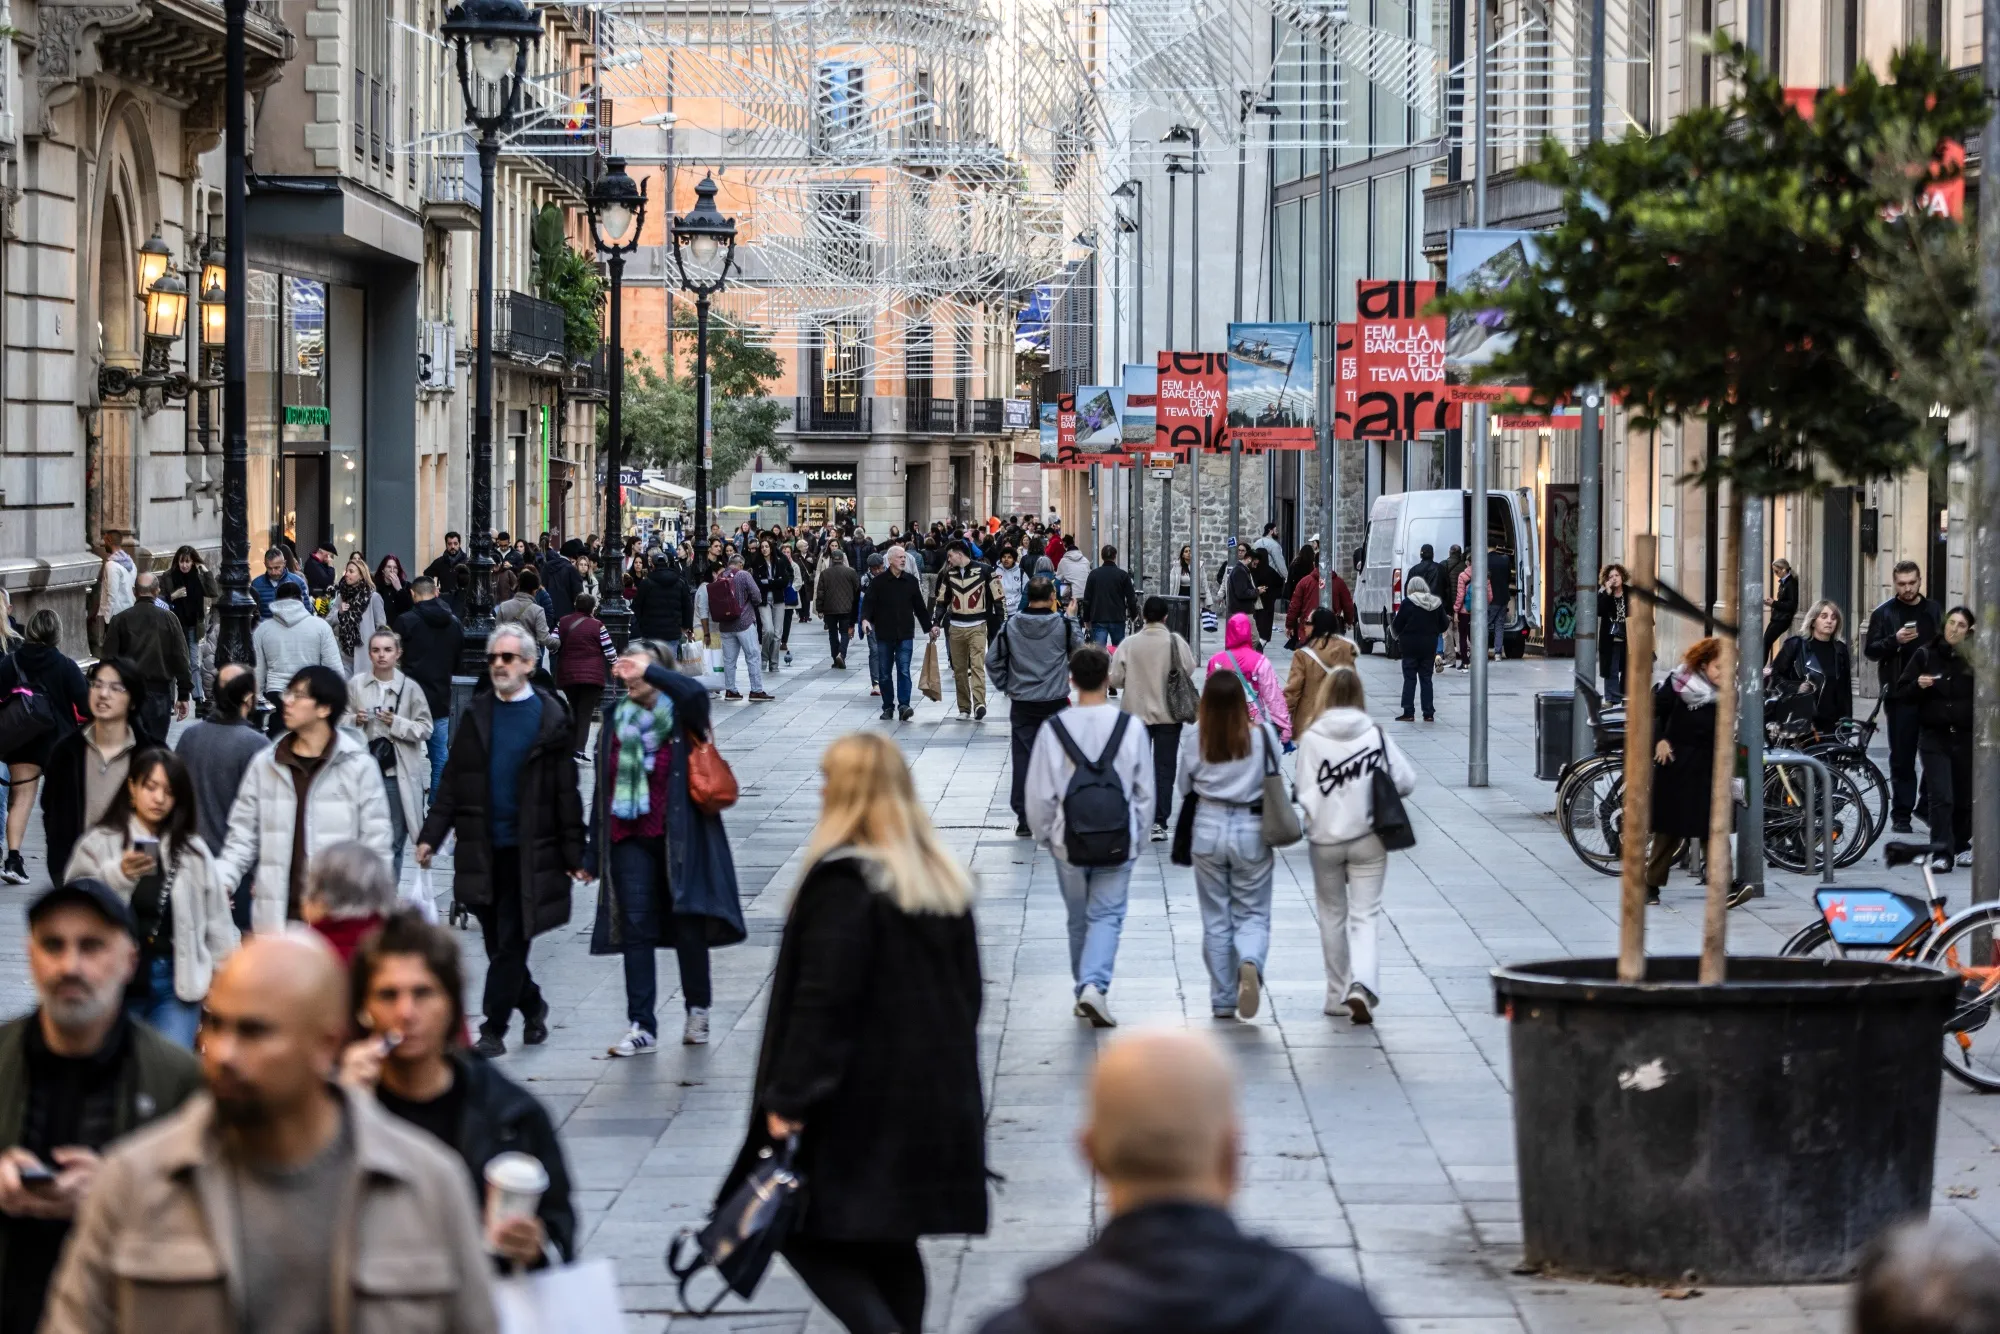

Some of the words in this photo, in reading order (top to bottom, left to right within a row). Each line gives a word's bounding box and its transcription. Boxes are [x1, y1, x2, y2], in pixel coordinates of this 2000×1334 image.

[1364, 325, 1396, 340] FEM
[1408, 325, 1429, 340] LA
[1407, 354, 1429, 368] DE
[1368, 367, 1408, 382] TEVA
[1410, 368, 1446, 382] VIDA
[1161, 380, 1183, 390] FEM
[1190, 380, 1204, 390] LA
[1161, 389, 1222, 400] BARCELONA
[1451, 389, 1501, 400] Barcelona
[1189, 399, 1203, 409] DE
[1204, 399, 1219, 409] LA
[1164, 407, 1190, 417] TEVA
[1191, 408, 1215, 418] VIDA
[1502, 419, 1545, 428] Barcelona
[1232, 430, 1267, 438] Barcelona
[1250, 441, 1278, 449] Barcelona
[821, 470, 853, 481] Locker
